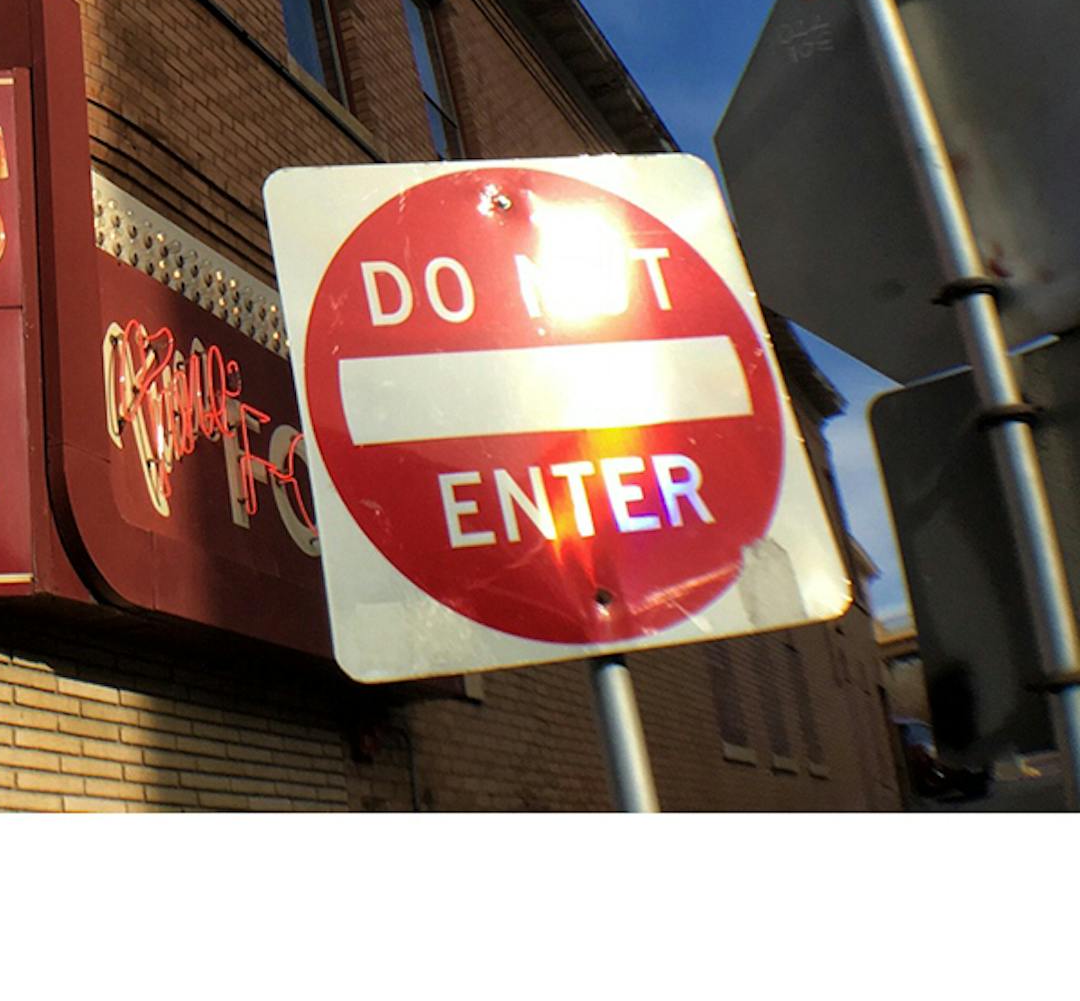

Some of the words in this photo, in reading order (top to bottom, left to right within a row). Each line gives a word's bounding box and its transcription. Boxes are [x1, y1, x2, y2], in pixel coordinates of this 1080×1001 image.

[360, 256, 476, 327] DO
[514, 247, 672, 322] NT
[437, 453, 717, 550] ENTER
